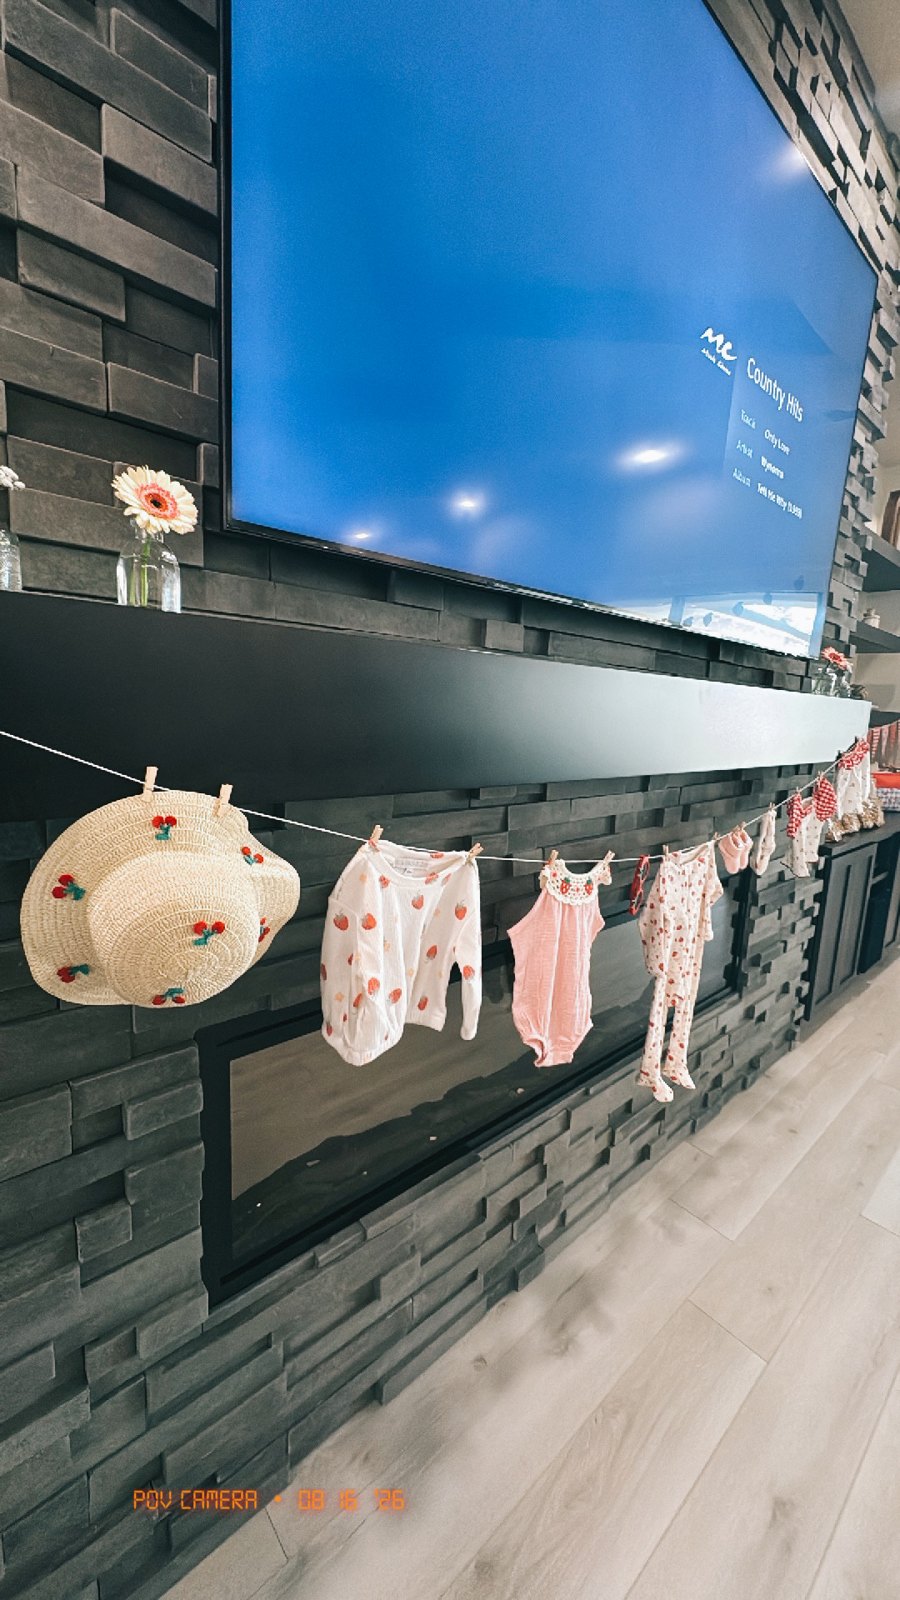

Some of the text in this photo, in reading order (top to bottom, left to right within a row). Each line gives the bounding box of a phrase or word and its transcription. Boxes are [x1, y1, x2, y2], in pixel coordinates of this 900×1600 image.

[747, 357, 786, 411] Country
[786, 392, 804, 422] Hits
[764, 429, 778, 448] Only
